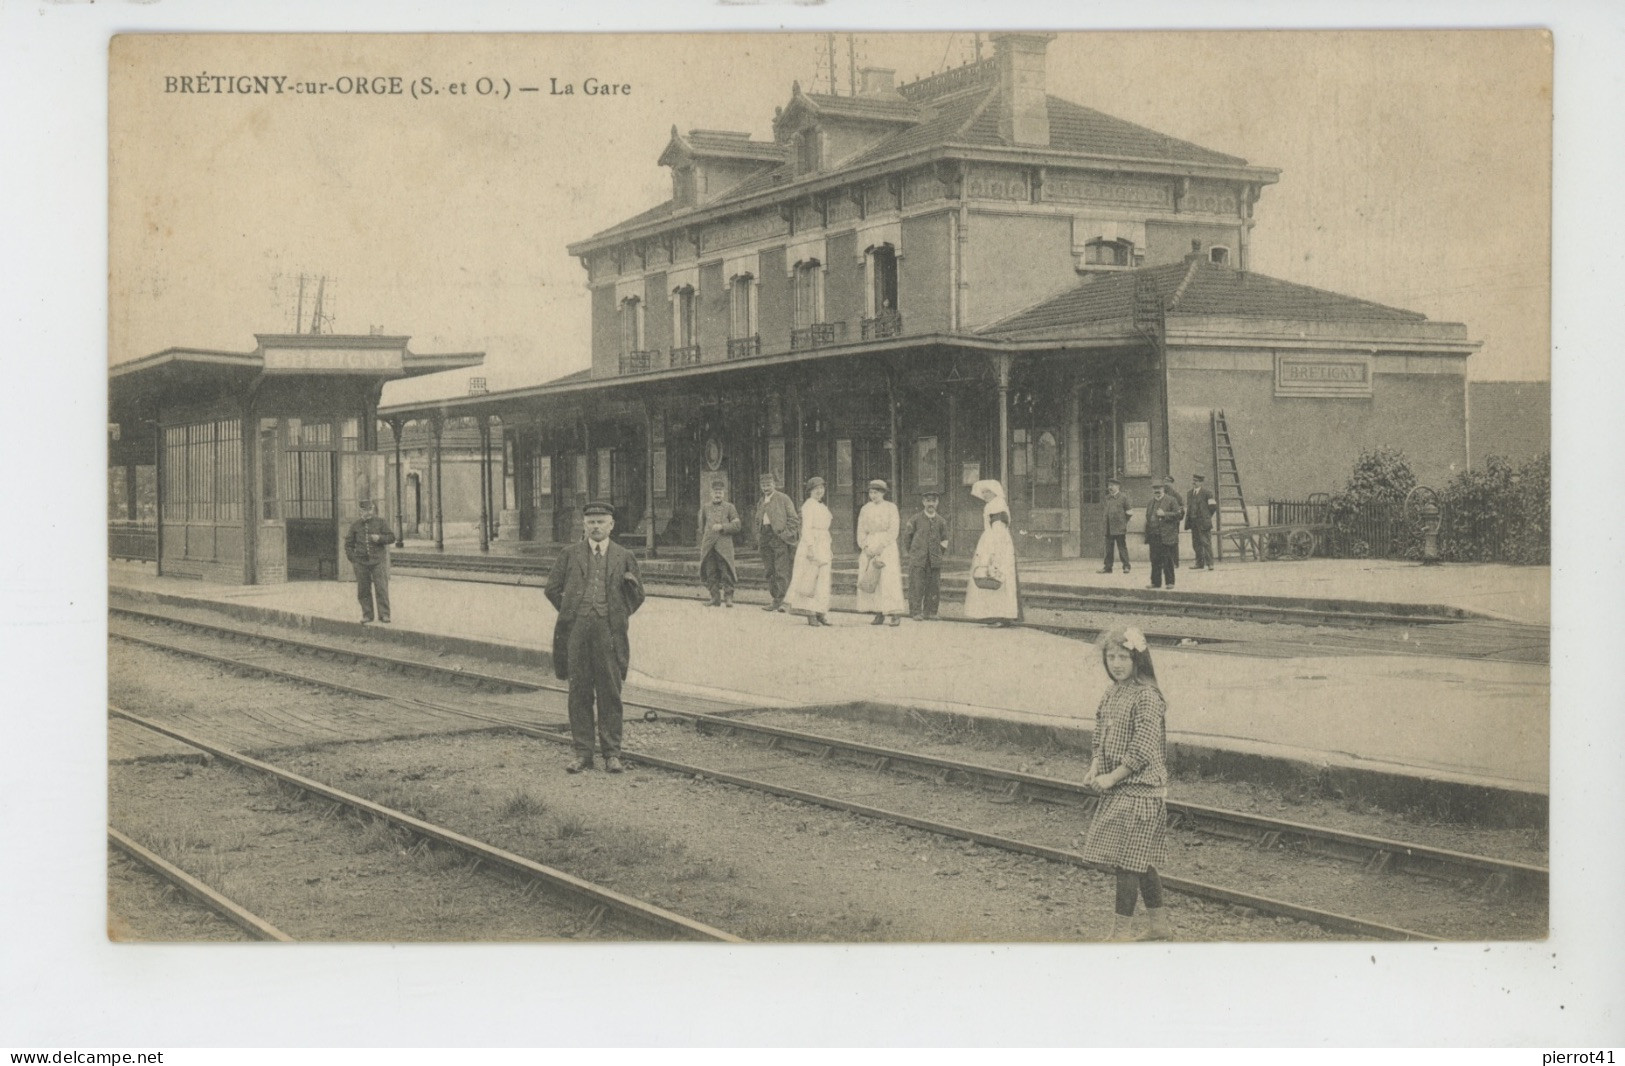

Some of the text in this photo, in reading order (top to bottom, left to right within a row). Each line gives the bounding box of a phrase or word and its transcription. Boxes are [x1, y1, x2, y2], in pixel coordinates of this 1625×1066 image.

[411, 77, 439, 99] (S.
[449, 81, 467, 95] et
[476, 77, 511, 99] O.)
[549, 77, 574, 95] La
[583, 77, 632, 95] Gare
